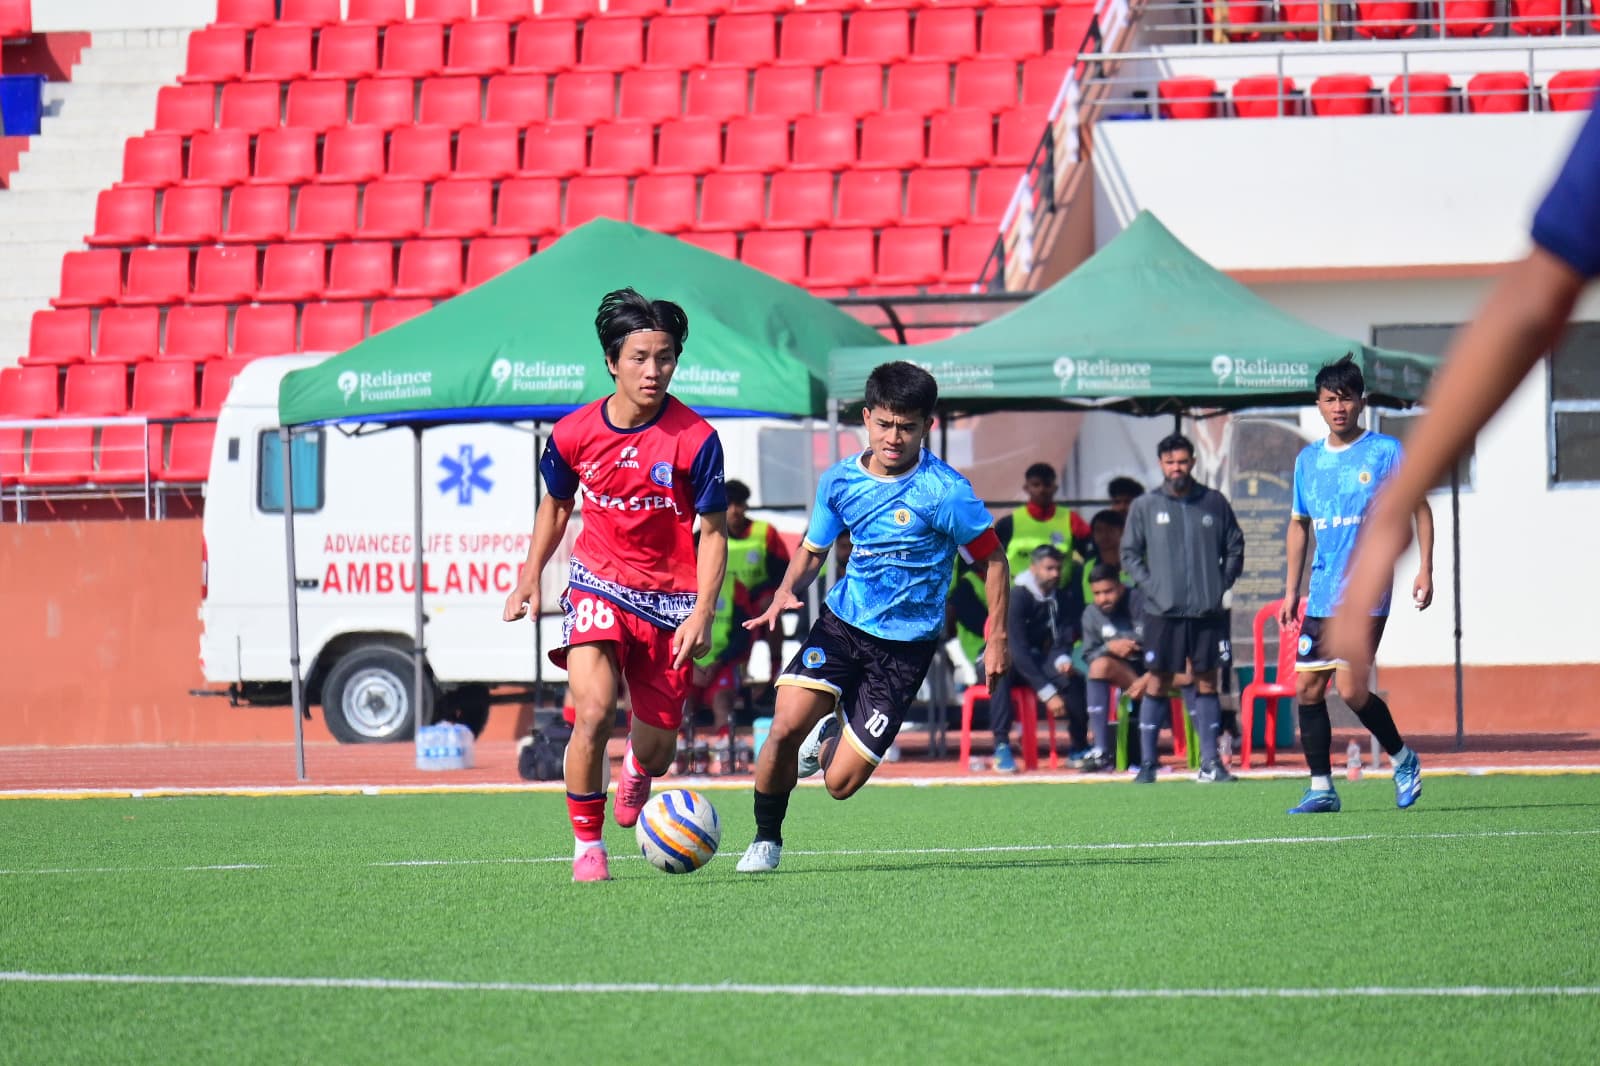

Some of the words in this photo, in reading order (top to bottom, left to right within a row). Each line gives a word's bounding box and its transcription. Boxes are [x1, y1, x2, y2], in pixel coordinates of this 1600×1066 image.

[513, 361, 585, 377] Reliance
[1077, 359, 1152, 377] Reliance
[1235, 357, 1309, 375] Reliance
[361, 369, 432, 388] Reliance
[512, 378, 584, 391] Foundation
[1235, 376, 1308, 388] Foundation
[361, 384, 432, 402] Foundation
[672, 382, 738, 396] oundation
[615, 460, 639, 469] TATA
[422, 533, 453, 553] IFE
[576, 598, 615, 633] 88
[864, 708, 889, 738] 10
